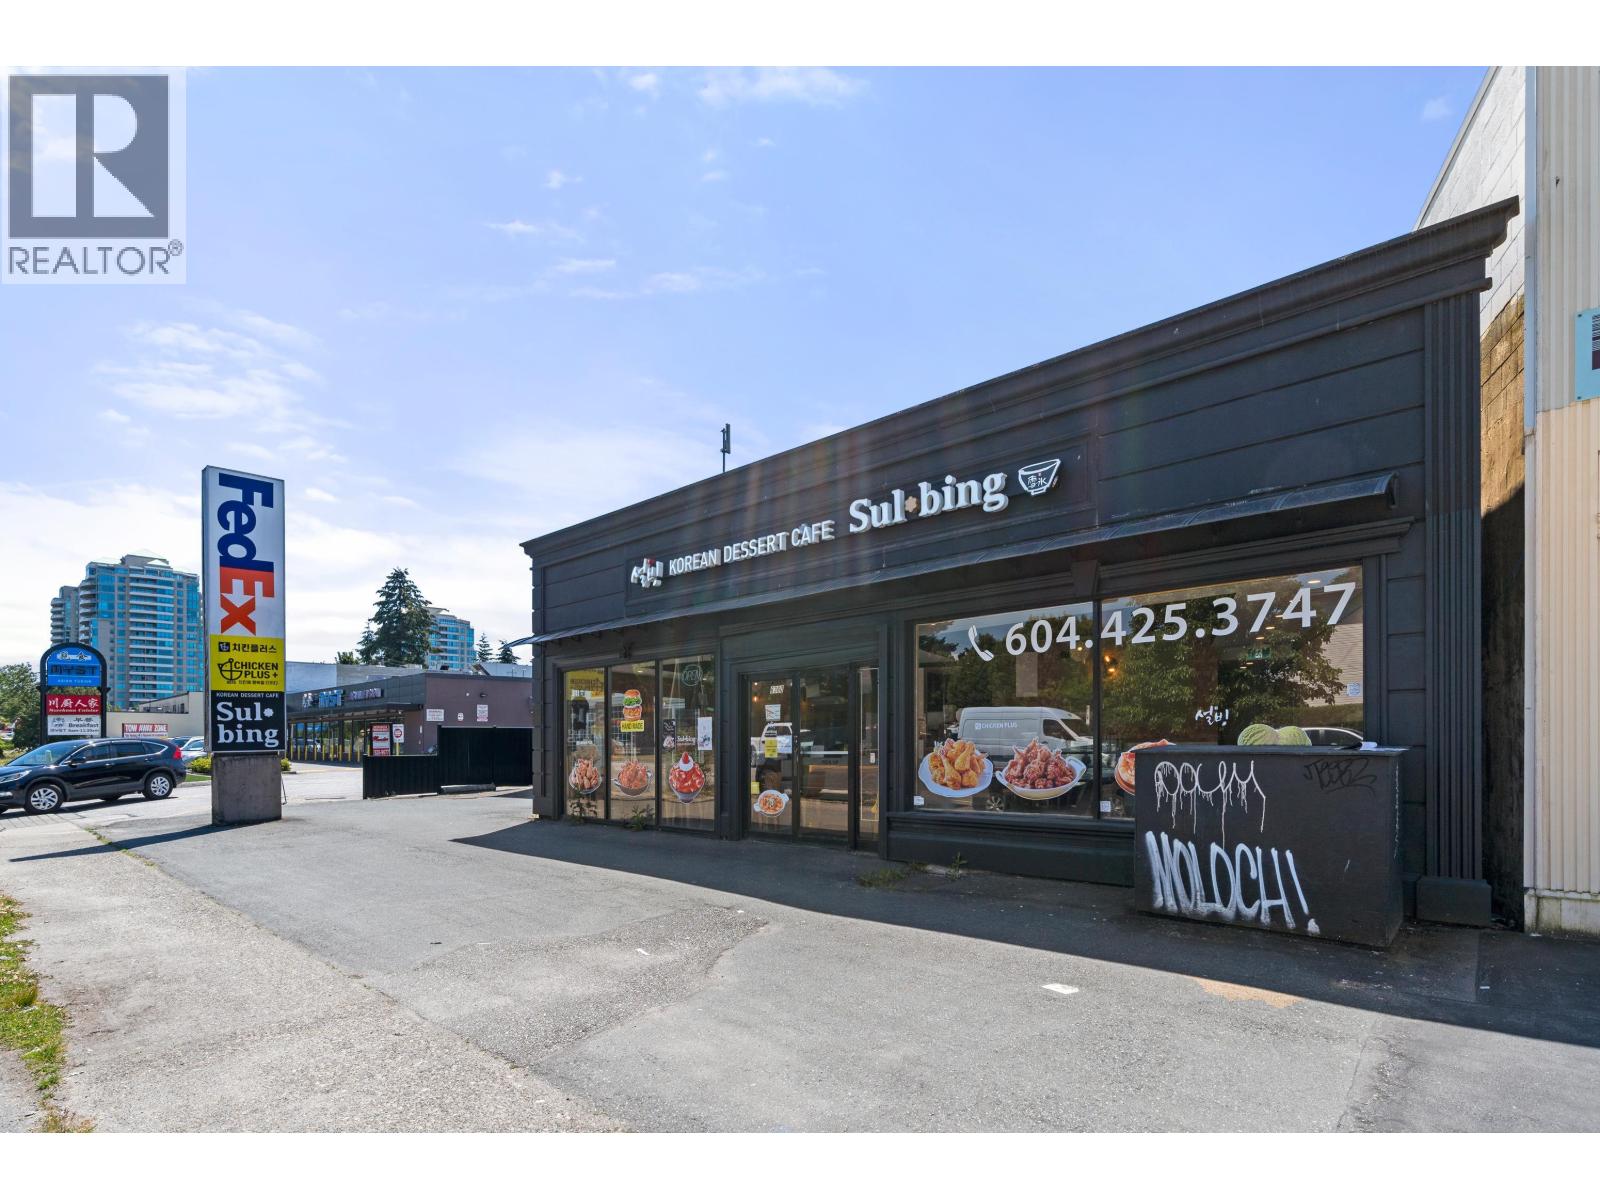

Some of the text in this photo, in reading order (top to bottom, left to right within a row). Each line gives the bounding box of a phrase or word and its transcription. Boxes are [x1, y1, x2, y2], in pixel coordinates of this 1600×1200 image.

[217, 472, 275, 636] FedEx
[669, 548, 721, 577] KOREAN
[723, 531, 790, 564] DESSERT
[791, 519, 836, 547] CAFE
[234, 661, 279, 671] CHICKEN
[244, 671, 271, 679] PLUS
[1195, 705, 1229, 727] 설빙
[125, 724, 167, 732] TOW AWAY ZONE
[217, 723, 280, 748] bing
